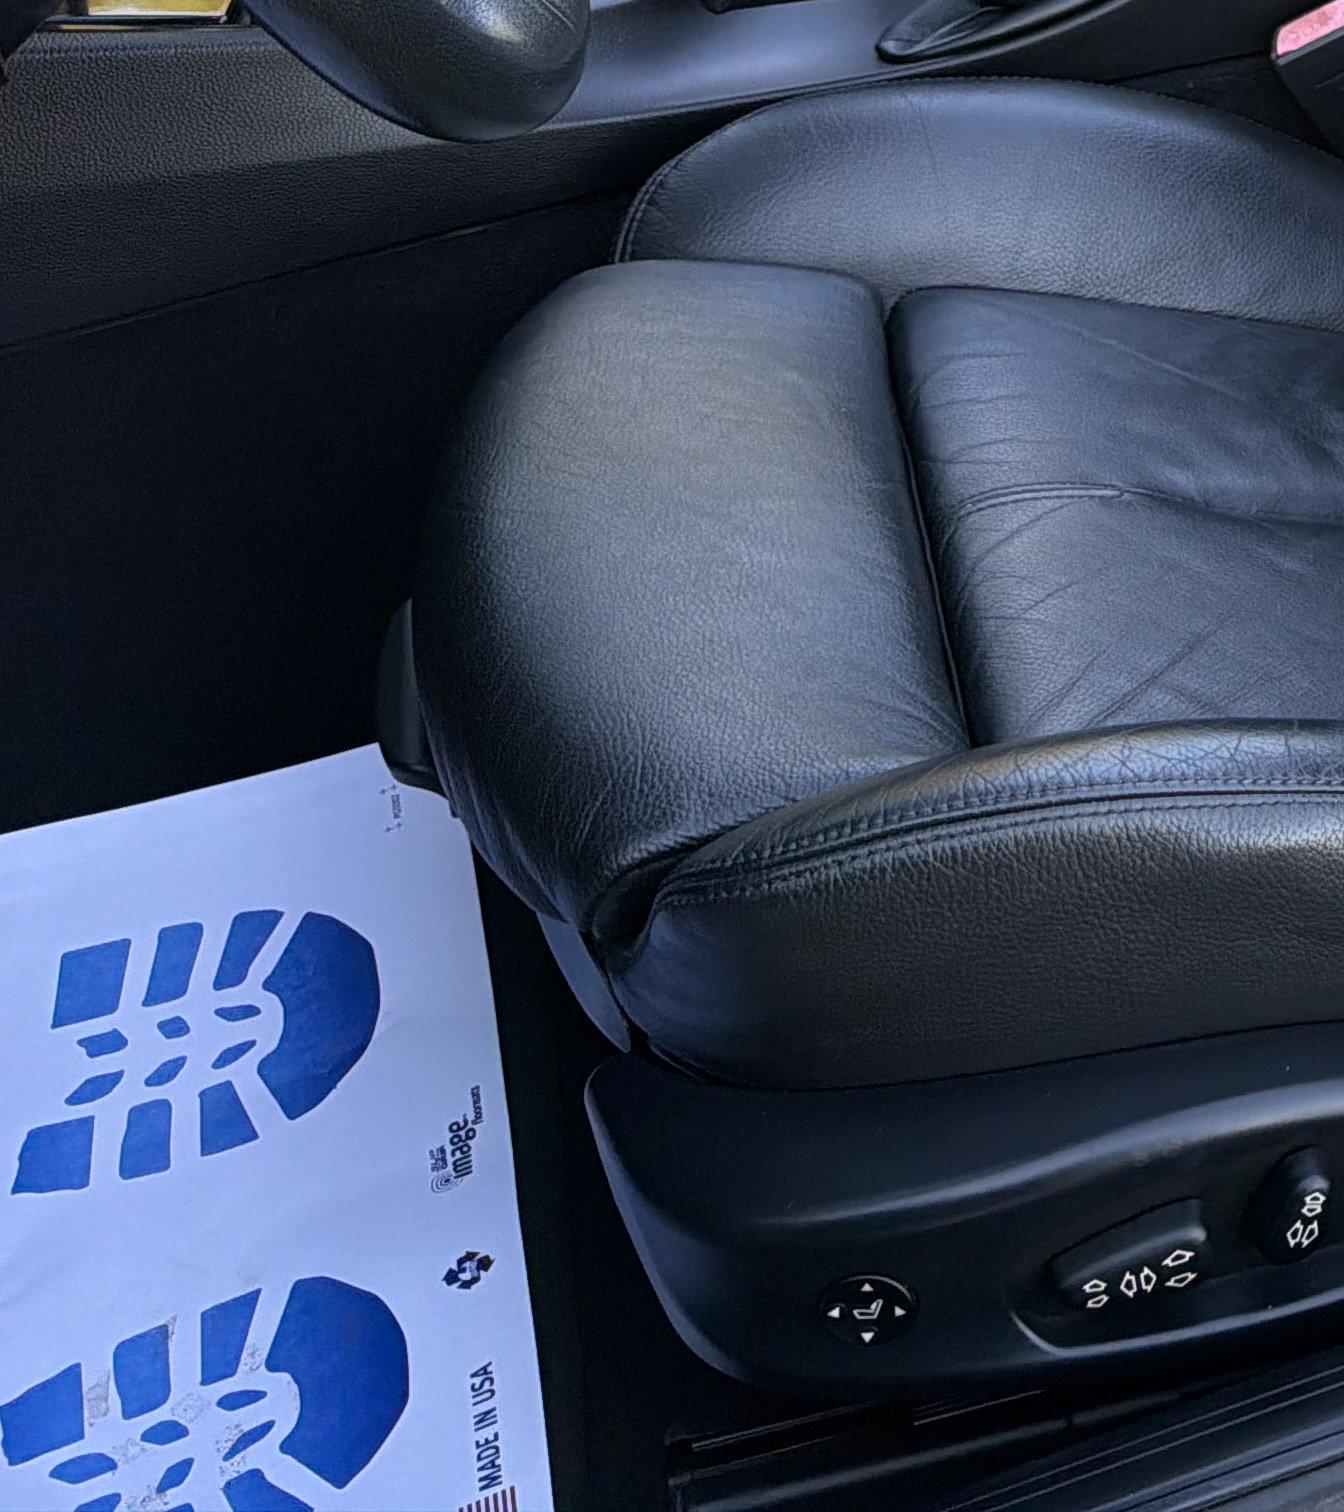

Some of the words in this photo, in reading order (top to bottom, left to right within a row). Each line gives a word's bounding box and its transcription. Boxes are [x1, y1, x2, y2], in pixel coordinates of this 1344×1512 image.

[448, 1121, 473, 1179] image
[470, 1361, 495, 1406] USA
[473, 1407, 498, 1432] IN
[475, 1432, 503, 1492] MADE
